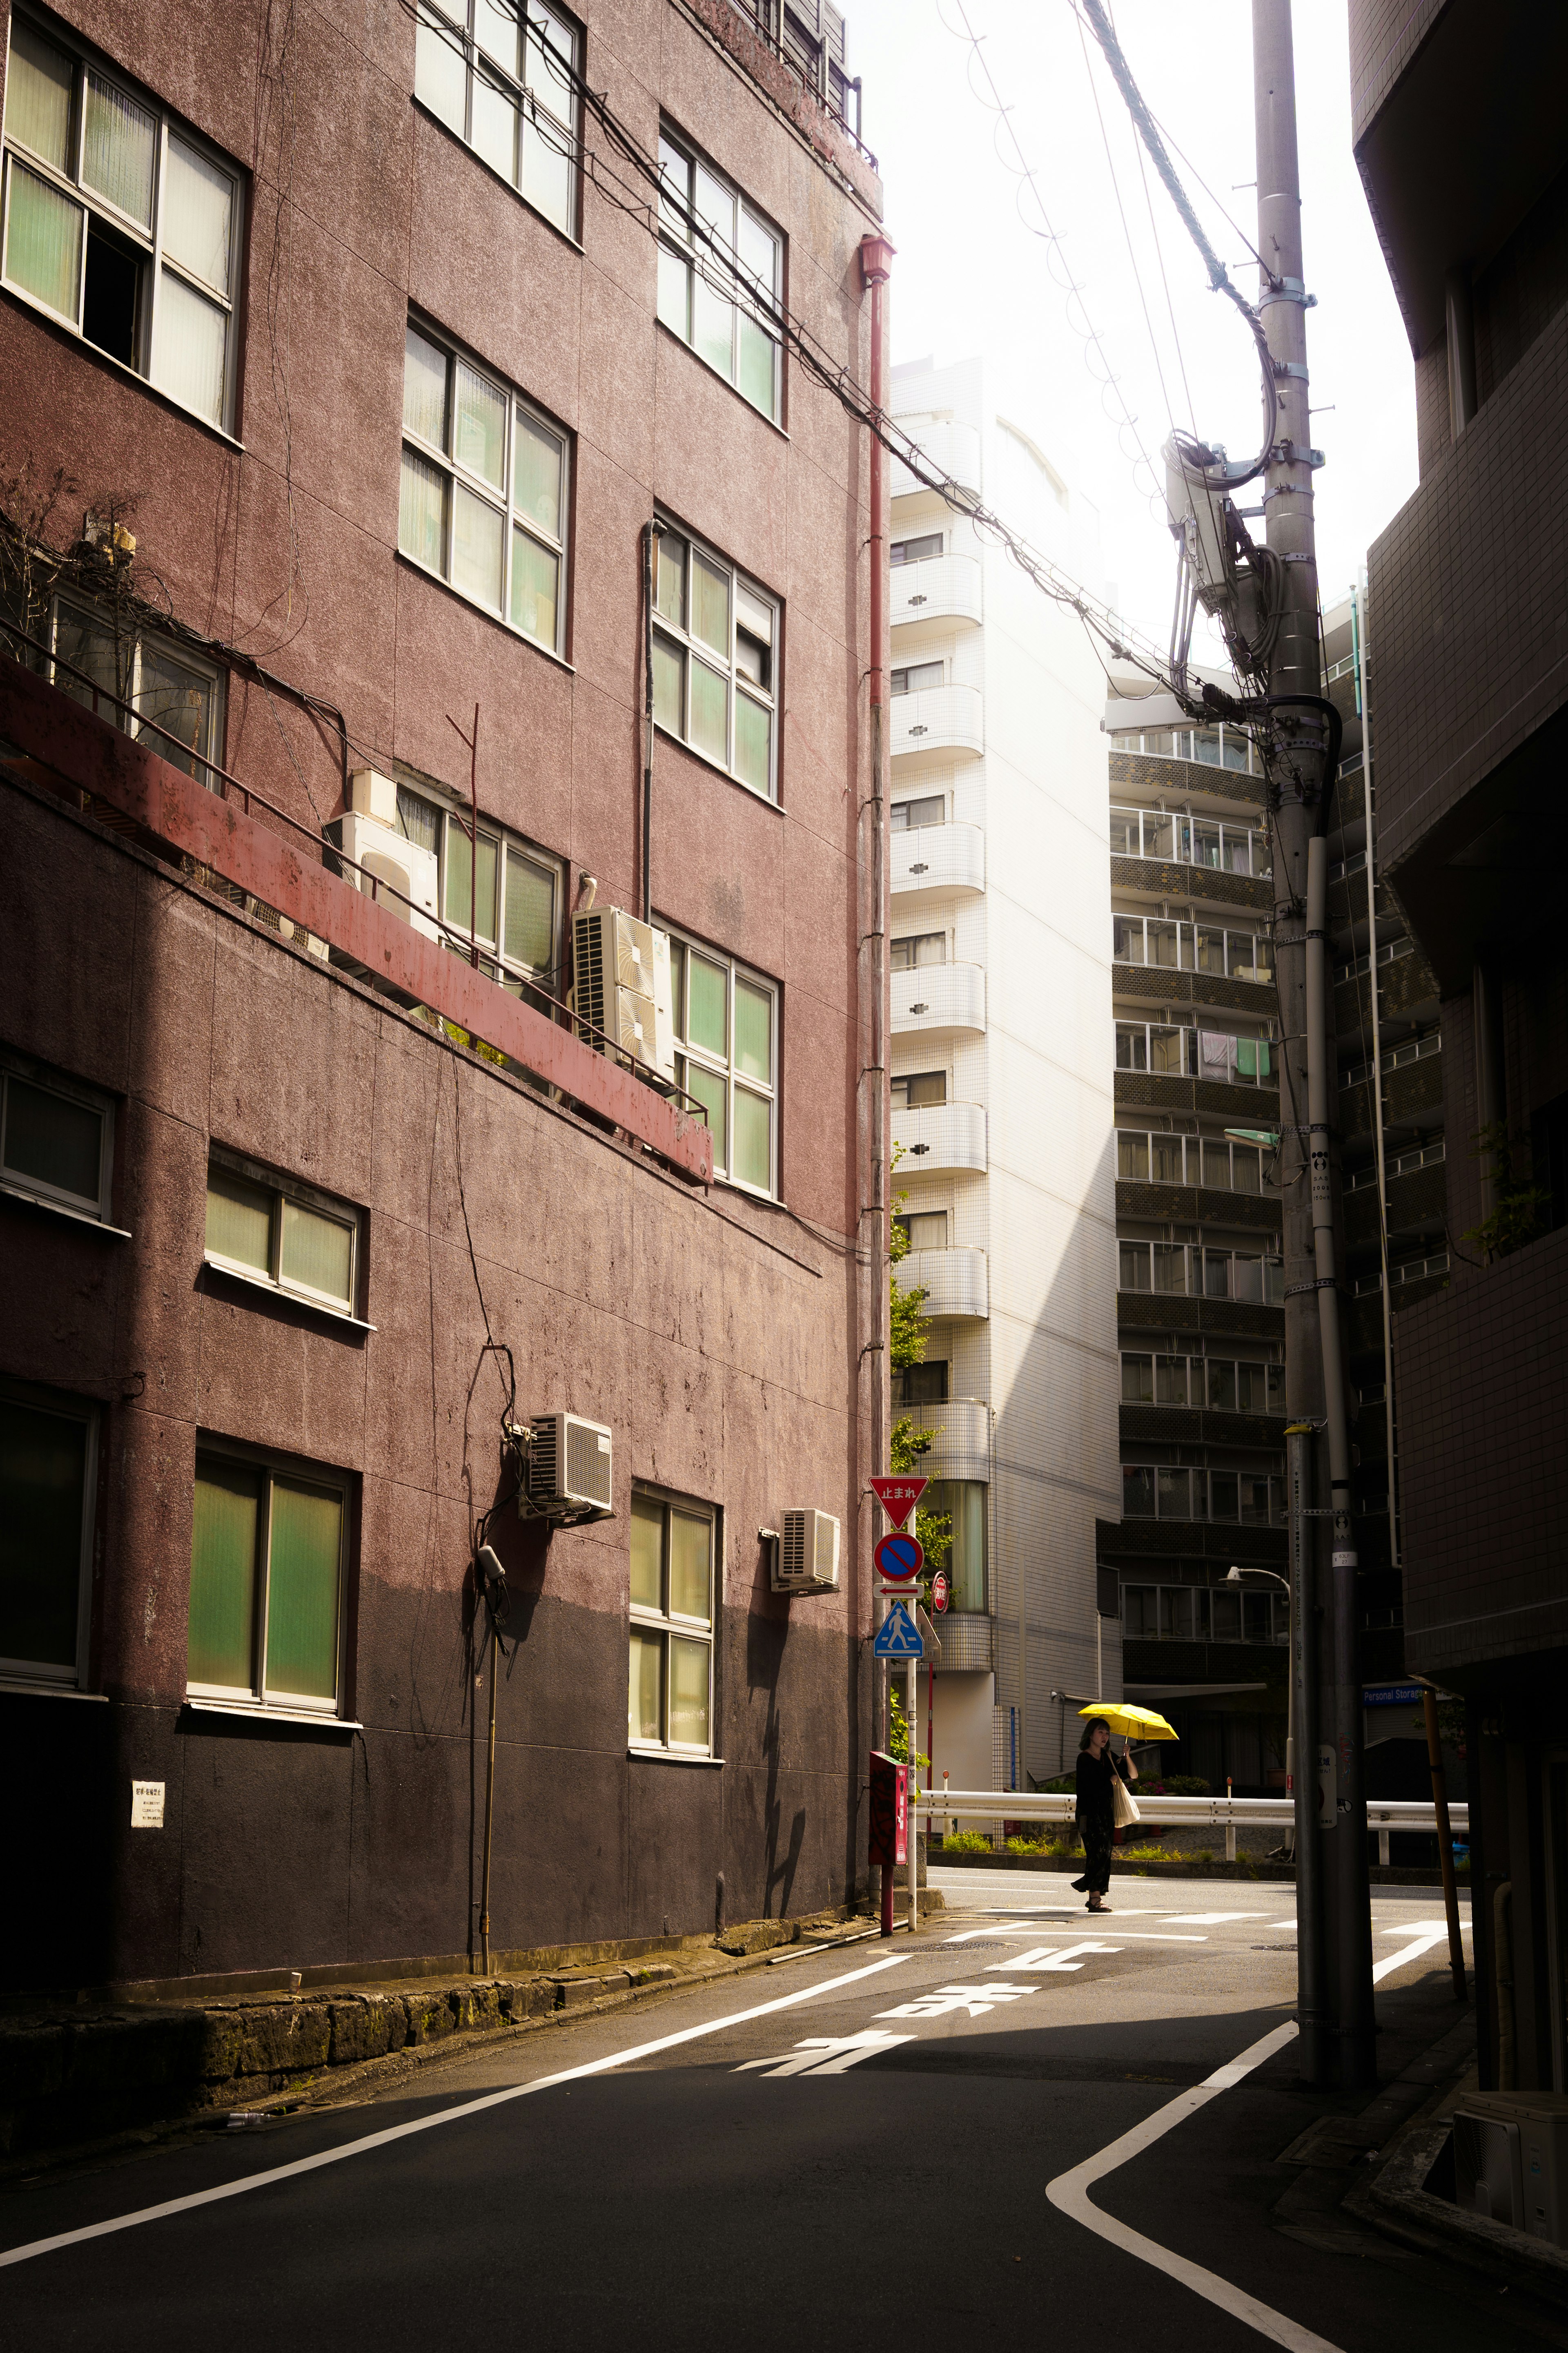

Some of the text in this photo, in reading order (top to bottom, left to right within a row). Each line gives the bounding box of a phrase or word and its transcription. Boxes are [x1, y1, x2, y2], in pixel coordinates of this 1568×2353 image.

[881, 1487, 916, 1499] 止まれ
[936, 1587, 945, 1600] 消火栓
[1364, 1690, 1393, 1702] Personal
[136, 1788, 161, 1796] 駐車・駐輪禁止
[728, 1941, 1125, 2077] 止まれ
